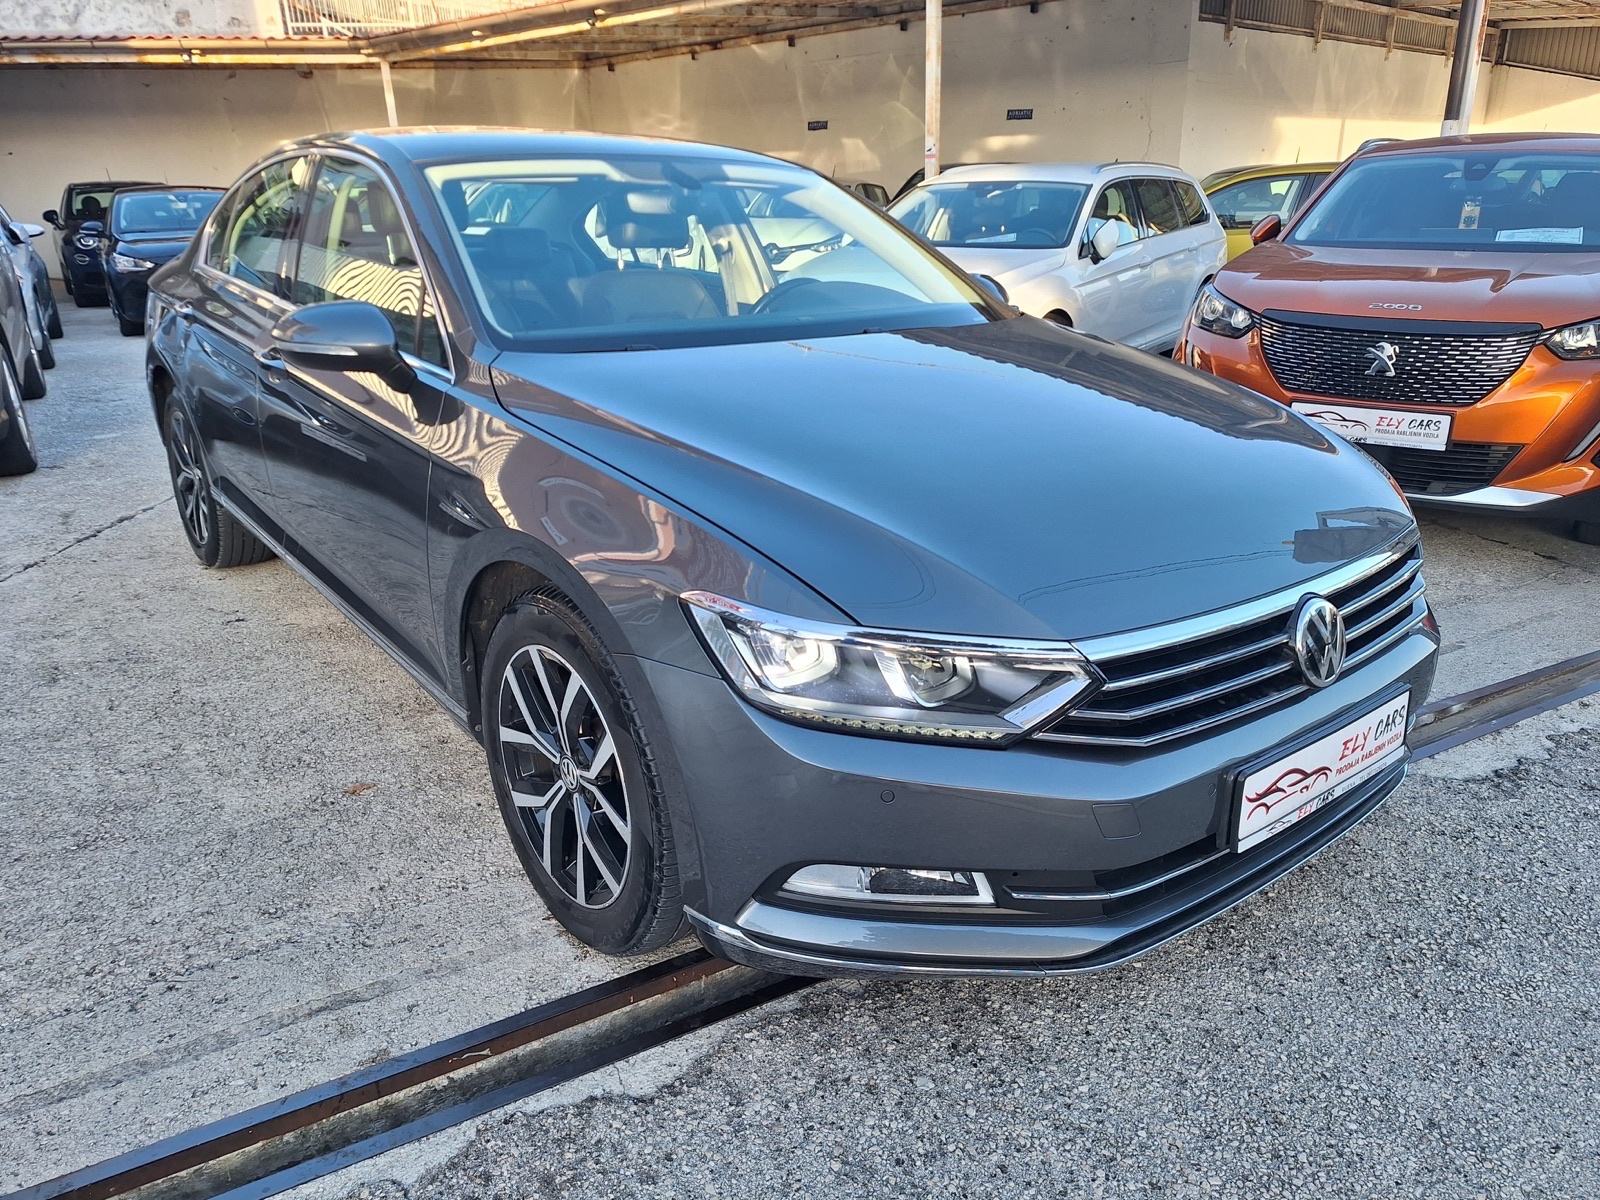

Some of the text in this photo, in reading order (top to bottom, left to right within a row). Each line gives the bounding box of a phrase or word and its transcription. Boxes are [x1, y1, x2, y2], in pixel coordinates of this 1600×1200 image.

[1368, 302, 1423, 311] 2008
[1376, 416, 1442, 432] ELY CARS
[1338, 704, 1406, 761] ELY CARS
[1335, 757, 1360, 777] PRODAJA
[1297, 789, 1335, 819] ELY CARS
